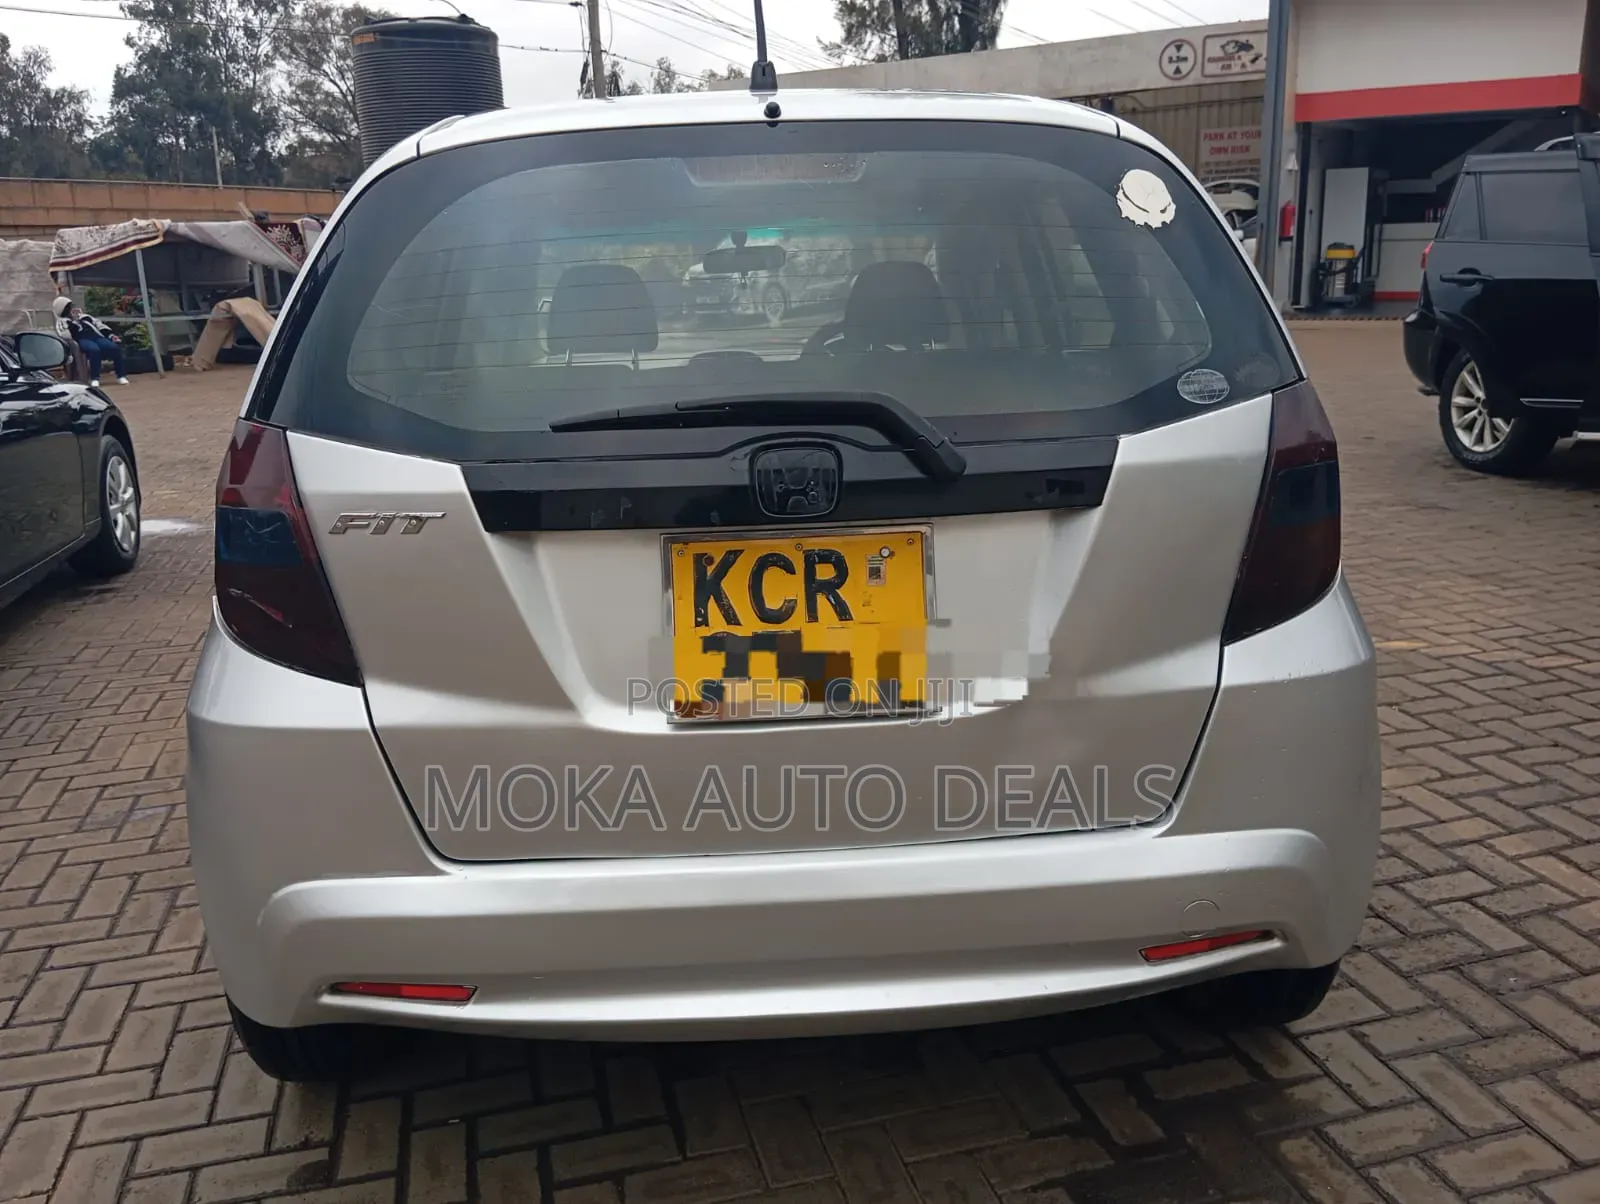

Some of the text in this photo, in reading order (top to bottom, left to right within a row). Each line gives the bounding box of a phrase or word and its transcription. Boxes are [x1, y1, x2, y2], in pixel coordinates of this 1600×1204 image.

[1203, 131, 1224, 141] PARK
[1227, 130, 1238, 140] AT
[1209, 144, 1251, 155] OWN RISK
[328, 511, 447, 535] FIT
[693, 549, 854, 627] KCR
